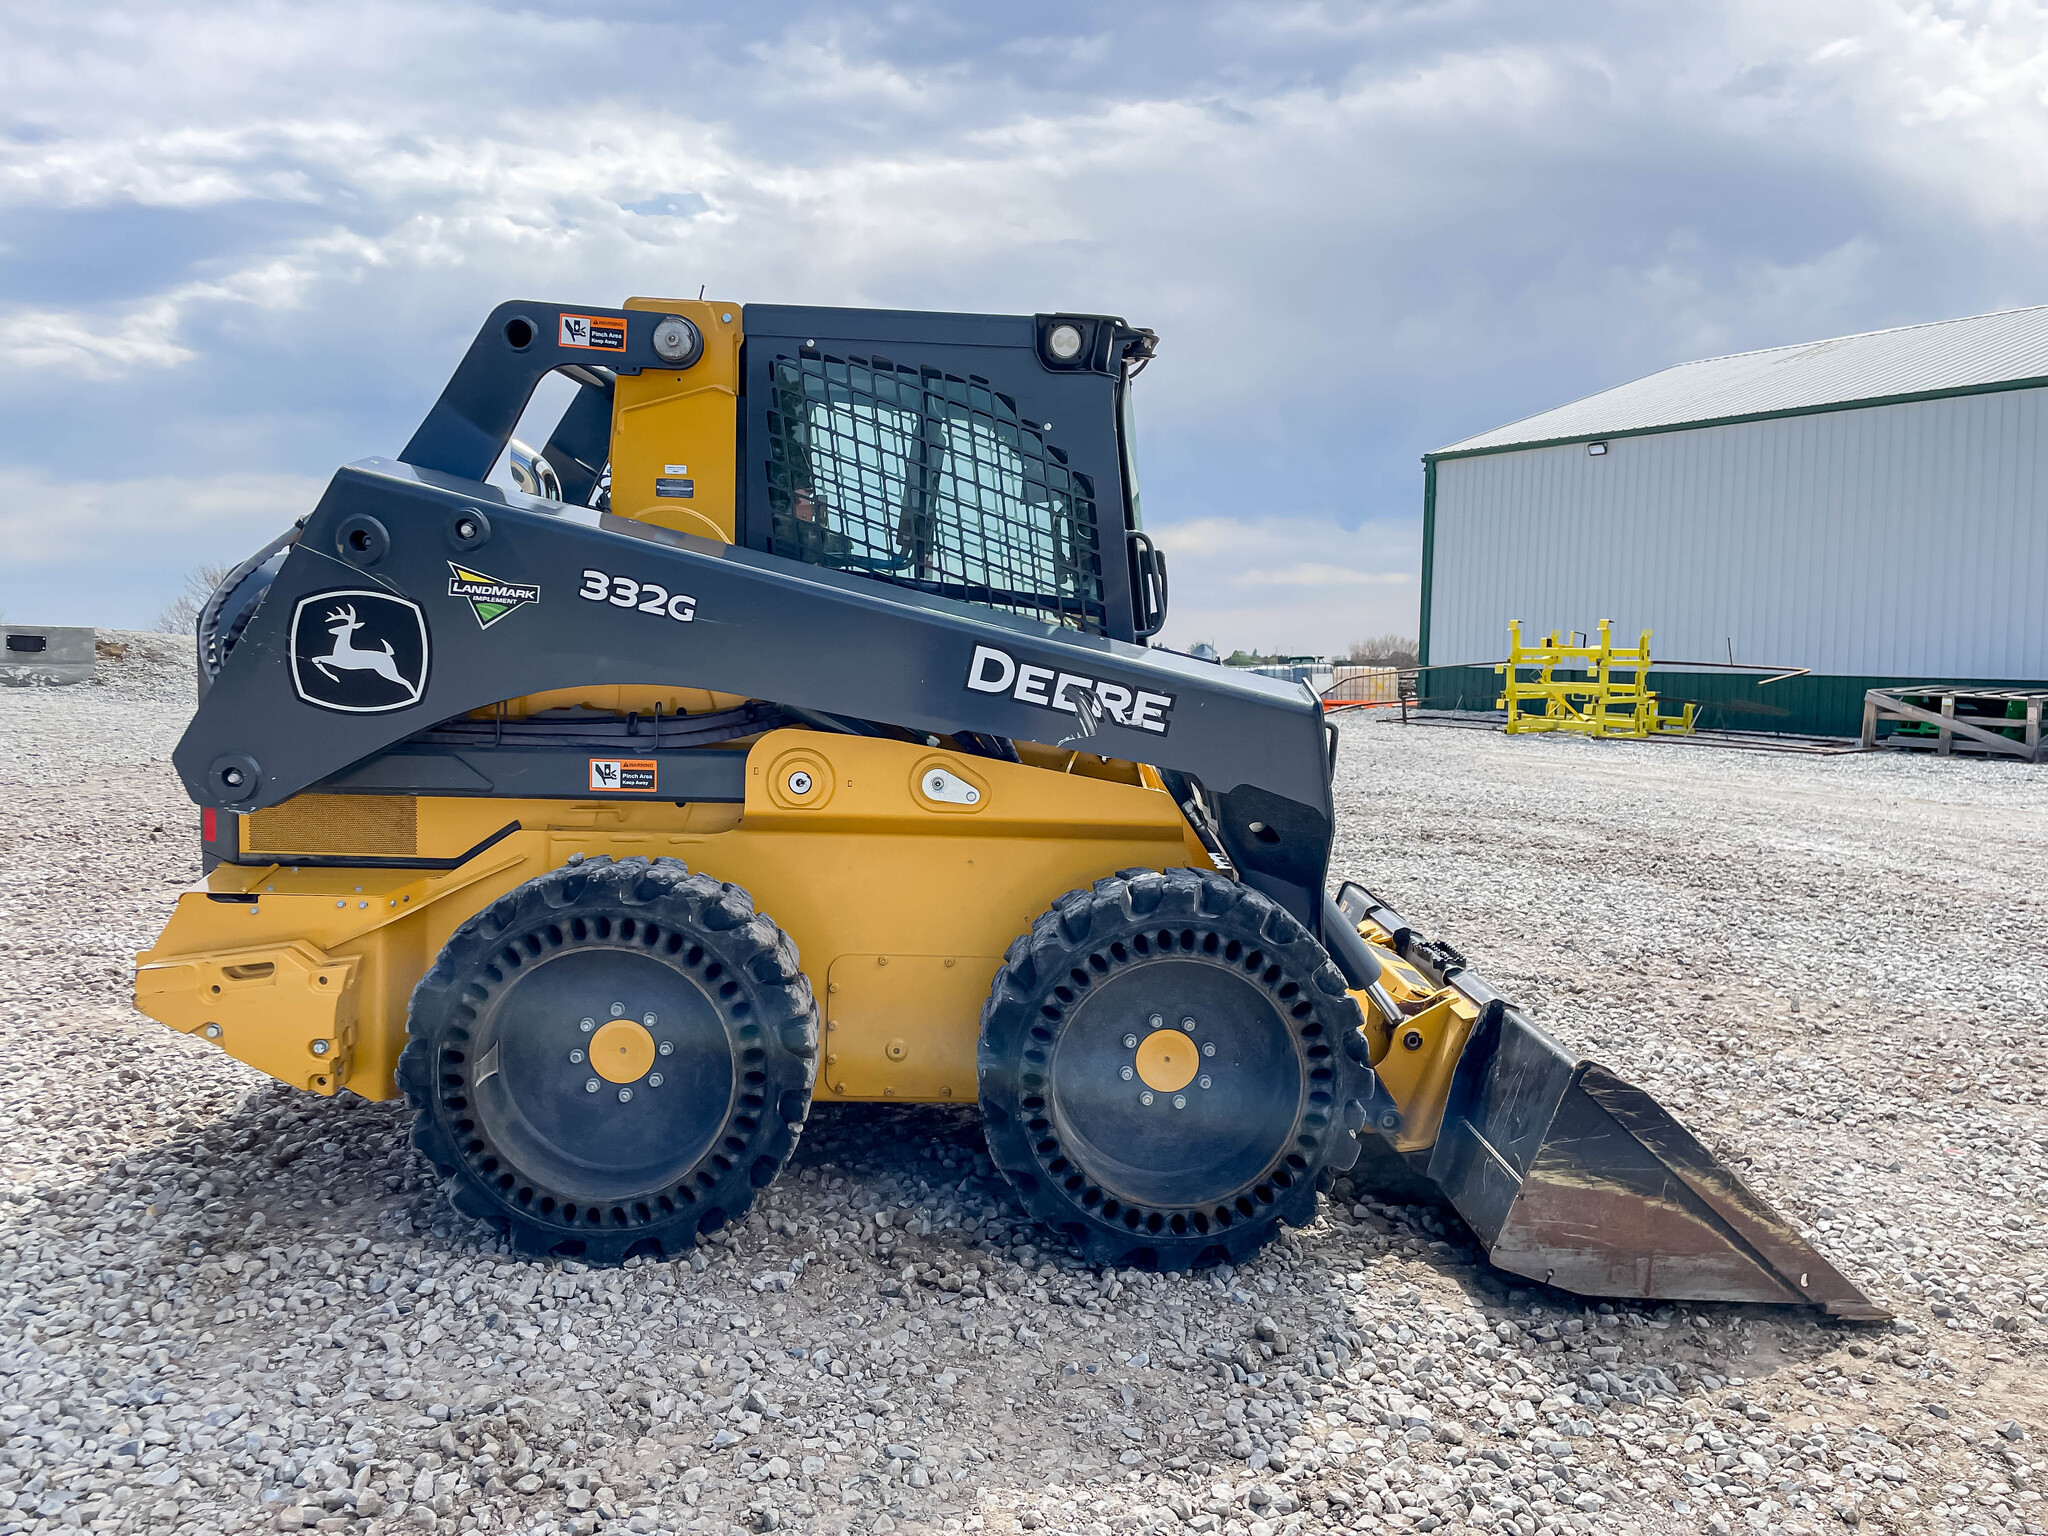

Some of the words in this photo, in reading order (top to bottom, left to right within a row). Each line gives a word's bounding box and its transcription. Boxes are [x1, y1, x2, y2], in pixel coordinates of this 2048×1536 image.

[591, 330, 608, 338] Pinch
[452, 582, 536, 600] LANDMARK
[472, 595, 518, 605] IMPLEMENT
[579, 570, 696, 622] 332G
[967, 645, 1172, 733] DEERE
